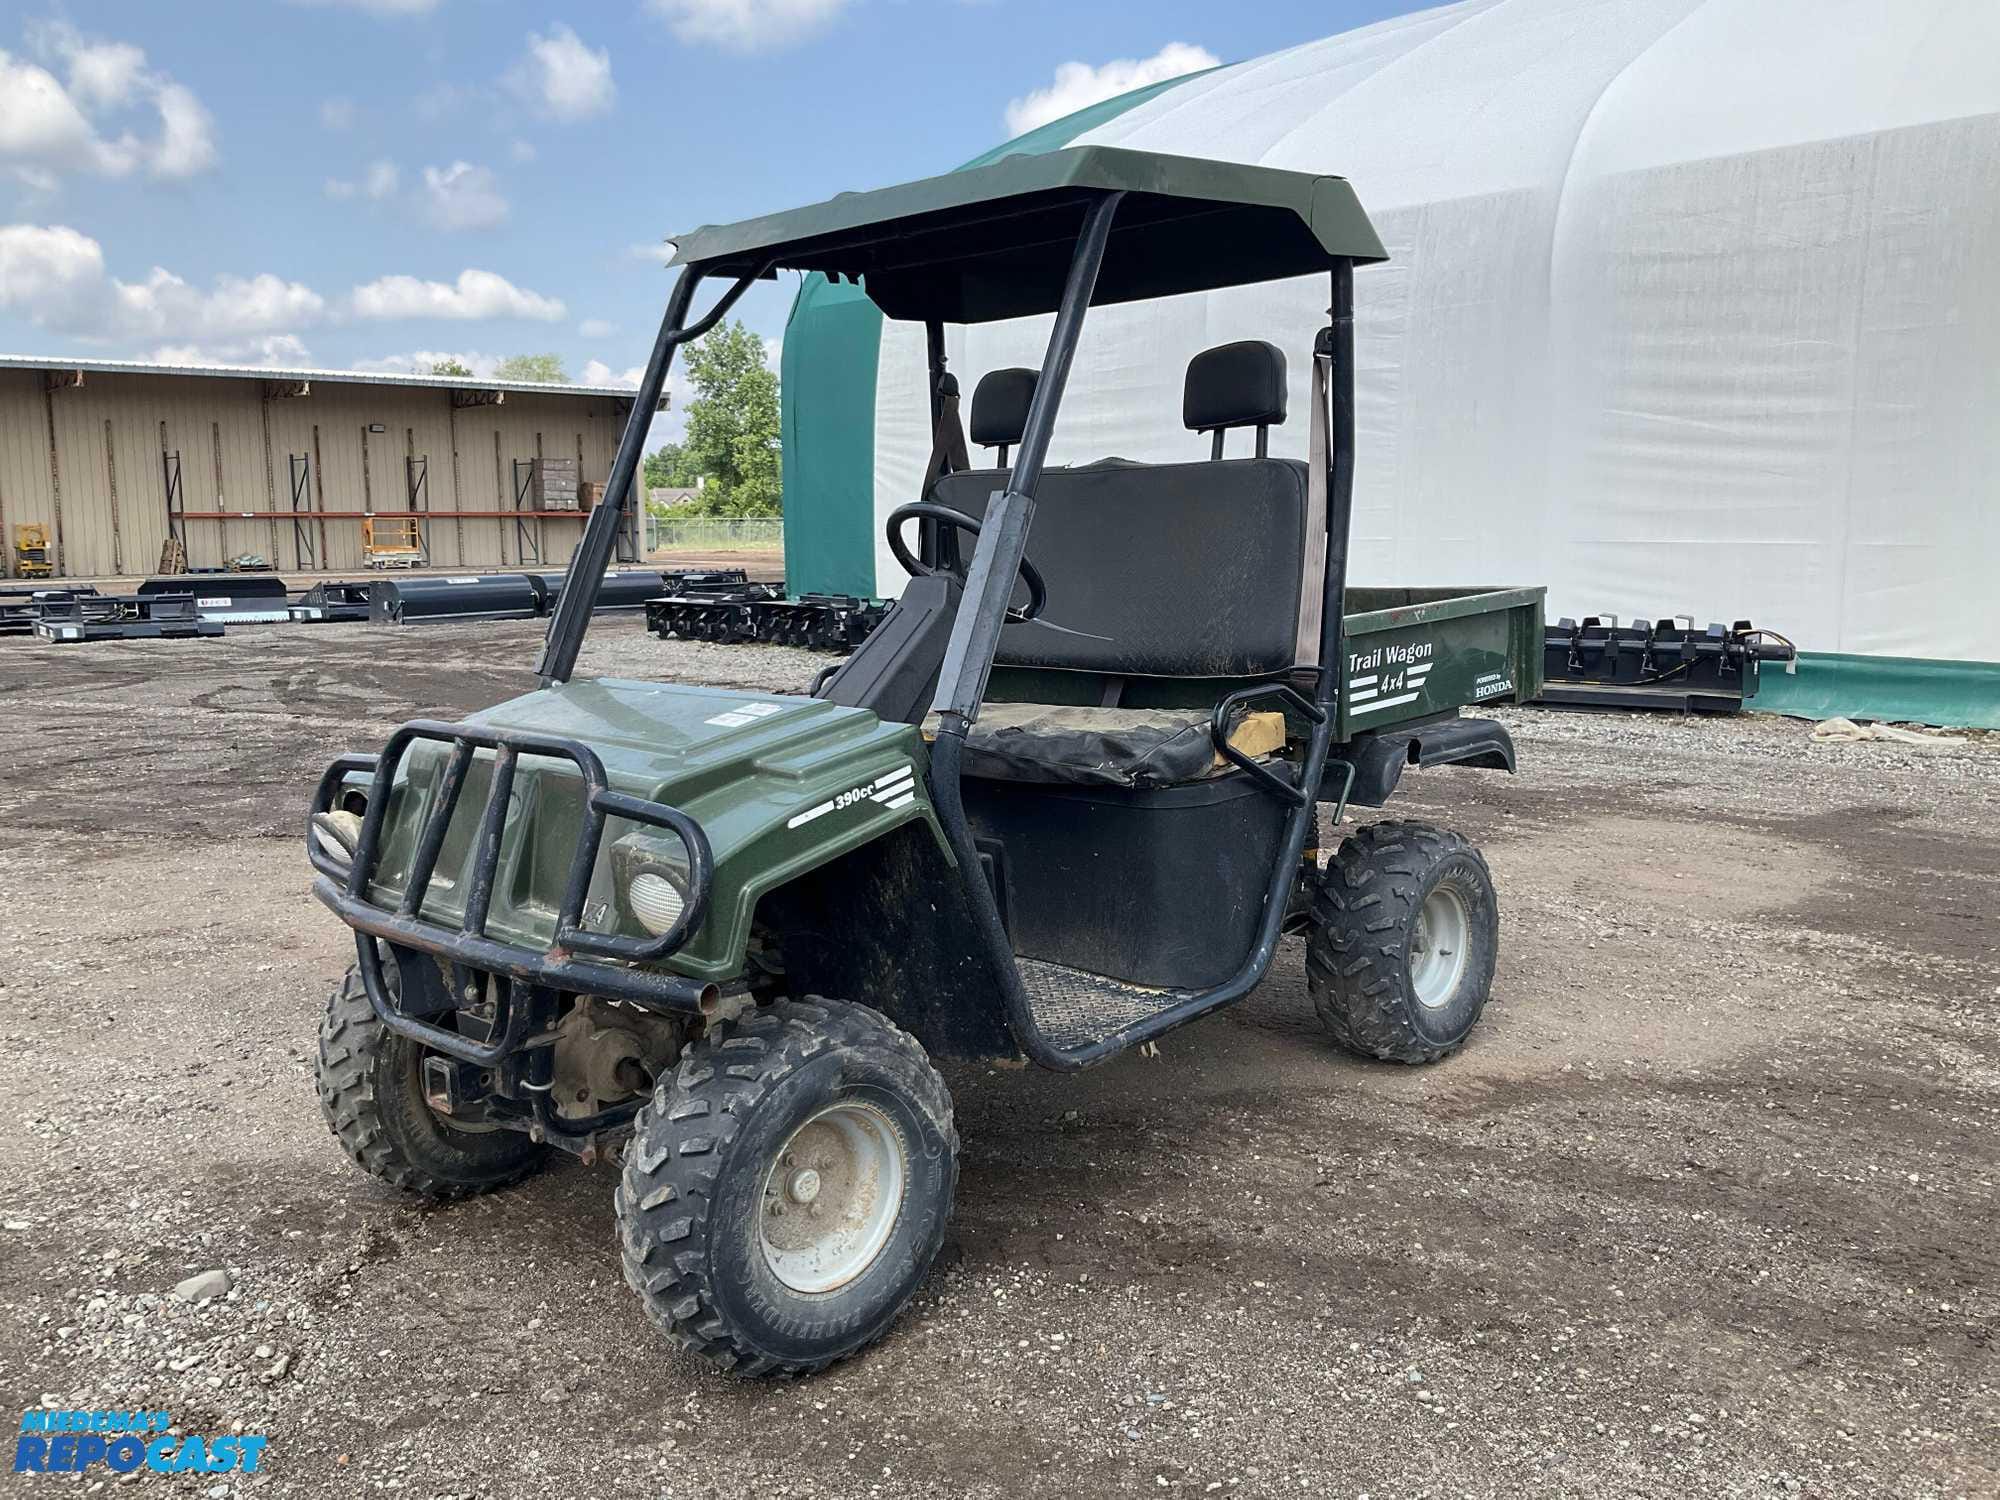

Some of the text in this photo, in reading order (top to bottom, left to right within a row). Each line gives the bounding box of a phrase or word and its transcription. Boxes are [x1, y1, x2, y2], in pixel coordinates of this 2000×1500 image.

[1350, 642, 1432, 672] Trail Wagon
[1381, 671, 1404, 693] 4x4
[1474, 679, 1513, 698] HONDA
[835, 784, 874, 810] 390cc
